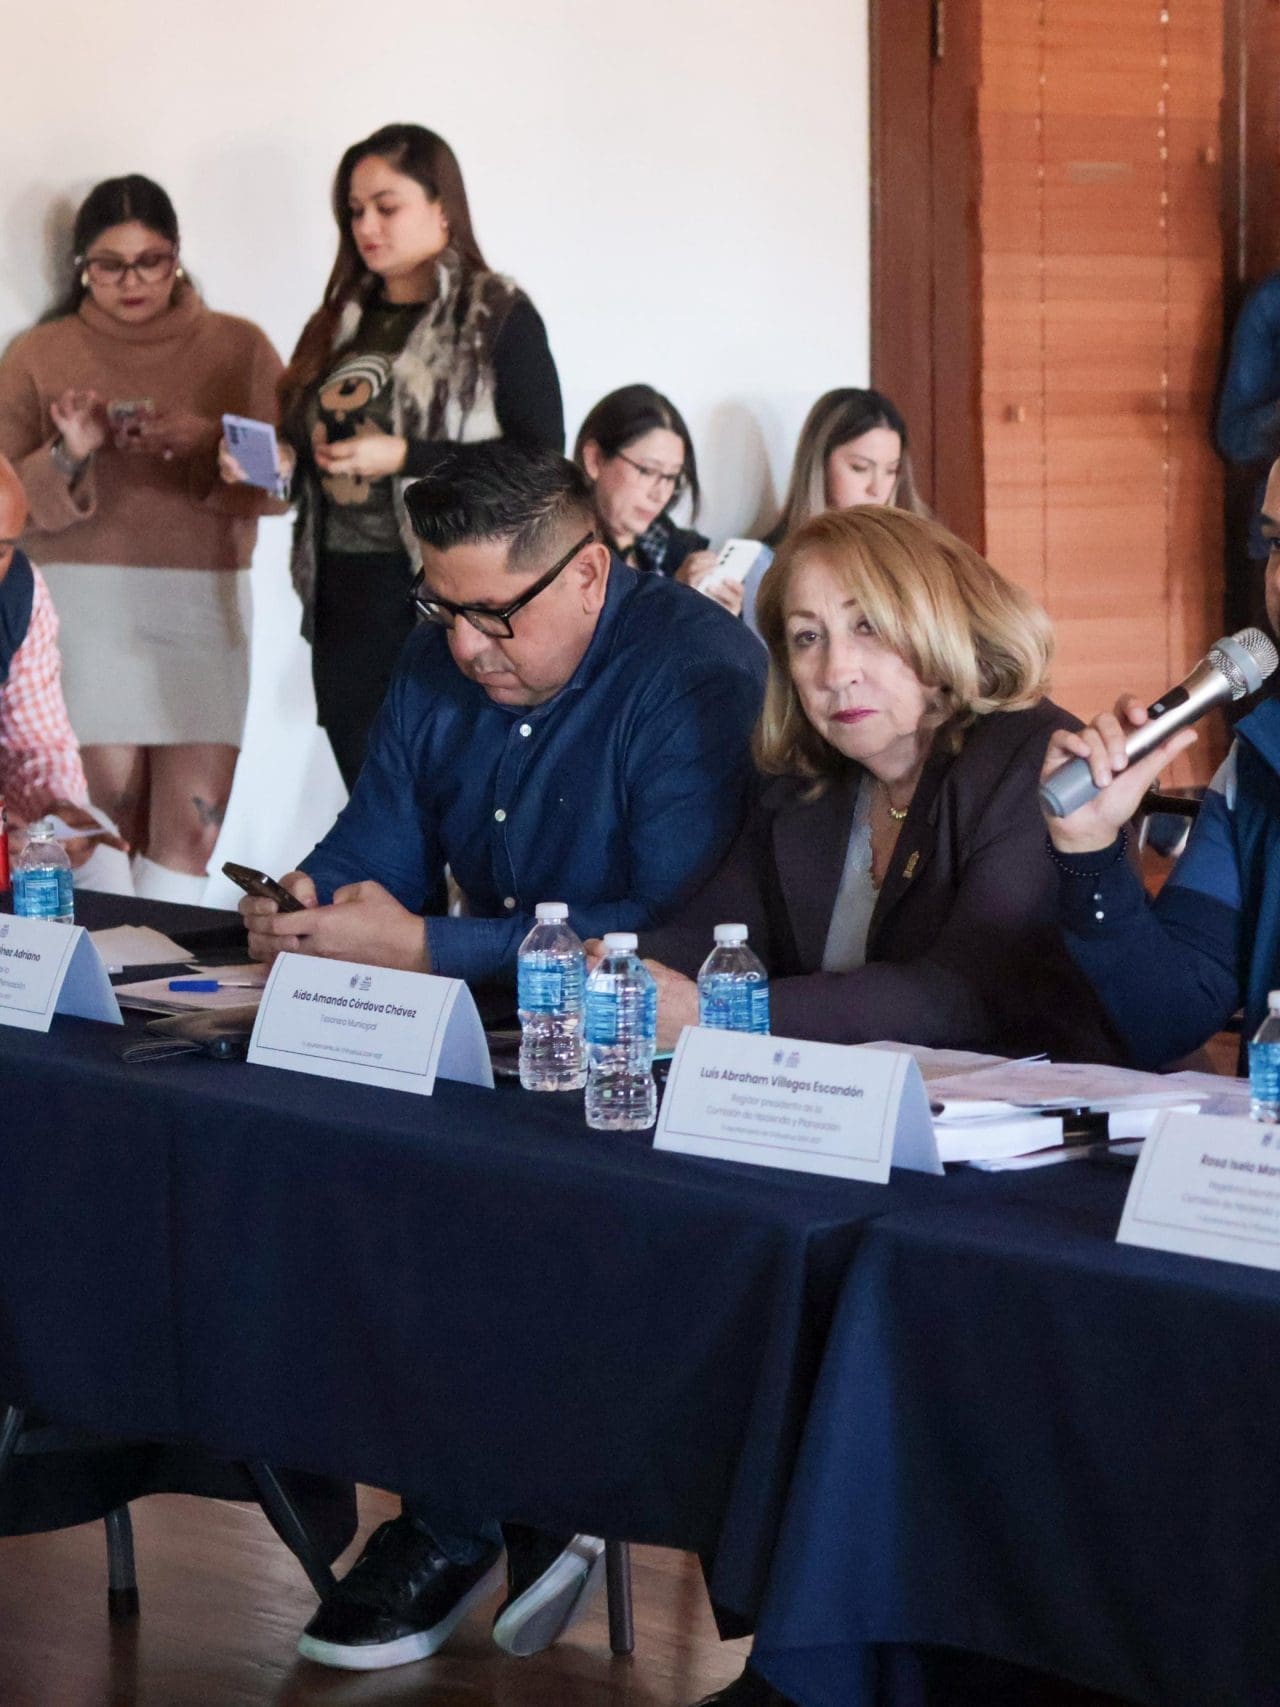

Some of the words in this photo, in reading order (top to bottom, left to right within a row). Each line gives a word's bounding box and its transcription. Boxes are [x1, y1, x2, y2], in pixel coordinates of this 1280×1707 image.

[13, 948, 41, 962] Adriano
[312, 992, 348, 1007] Amanda
[348, 998, 385, 1013] Córdova
[385, 1004, 417, 1018] Chávez
[720, 1069, 769, 1085] Abraham
[771, 1075, 811, 1093] Villegas
[813, 1081, 864, 1097] Escandón
